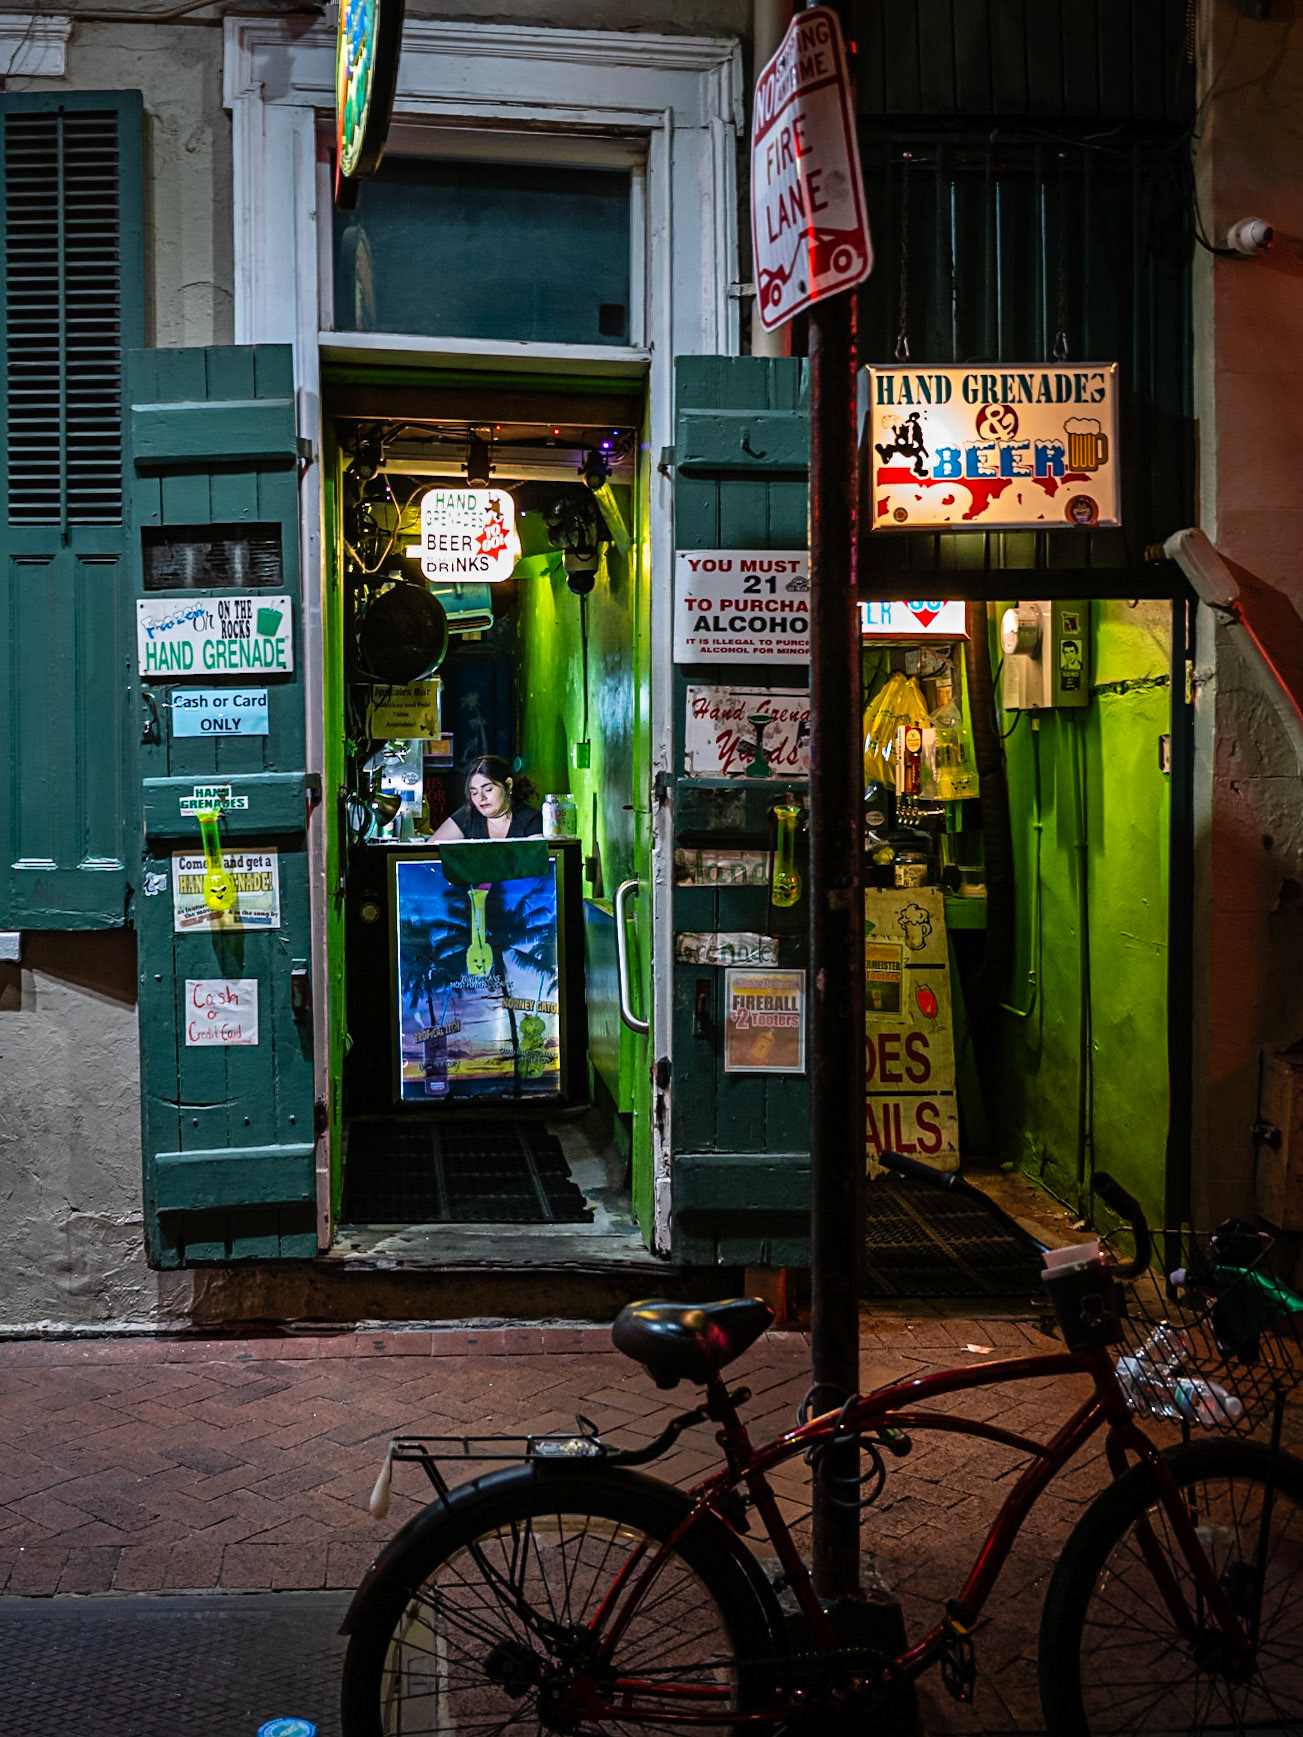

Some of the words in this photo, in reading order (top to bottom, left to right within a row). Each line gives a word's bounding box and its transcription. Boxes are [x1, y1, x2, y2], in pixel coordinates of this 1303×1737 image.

[766, 114, 813, 185] FIRE
[766, 168, 828, 244] LANE
[876, 375, 952, 405] HAND
[962, 373, 1106, 405] GRENADES
[979, 404, 1017, 440] &
[932, 439, 1066, 479] BEER
[436, 492, 477, 511] HAND
[427, 534, 473, 552] BEER
[426, 556, 490, 573] DRINKS
[688, 559, 732, 573] YOU
[740, 559, 801, 574] MUST
[743, 574, 777, 594] 21
[218, 600, 231, 619] ON
[235, 600, 253, 619] THE
[684, 598, 713, 612] TO
[720, 599, 809, 613] PURCHA
[221, 620, 251, 639] ROCKS
[693, 615, 809, 633] ALCOHO
[700, 646, 750, 654] ALCOHOL
[712, 638, 755, 646] ILLEGAL
[145, 641, 194, 671] HAND
[203, 638, 287, 670] GRENADE
[174, 694, 209, 708] Cash
[213, 698, 228, 707] or
[233, 694, 267, 707] Card
[691, 697, 746, 721] Hand
[200, 718, 242, 731] ONLY
[715, 729, 799, 776] Yads
[178, 857, 208, 870] Come
[223, 855, 243, 868] and
[246, 855, 263, 871] get
[265, 857, 272, 867] a
[679, 850, 769, 884] Hand
[192, 983, 239, 1009] Cash
[732, 995, 798, 1011] FIREBALL
[207, 1010, 220, 1020] or
[731, 1007, 750, 1030] $2
[751, 1012, 800, 1028] Tooters
[188, 1021, 218, 1042] Credit
[221, 1023, 242, 1041] Card
